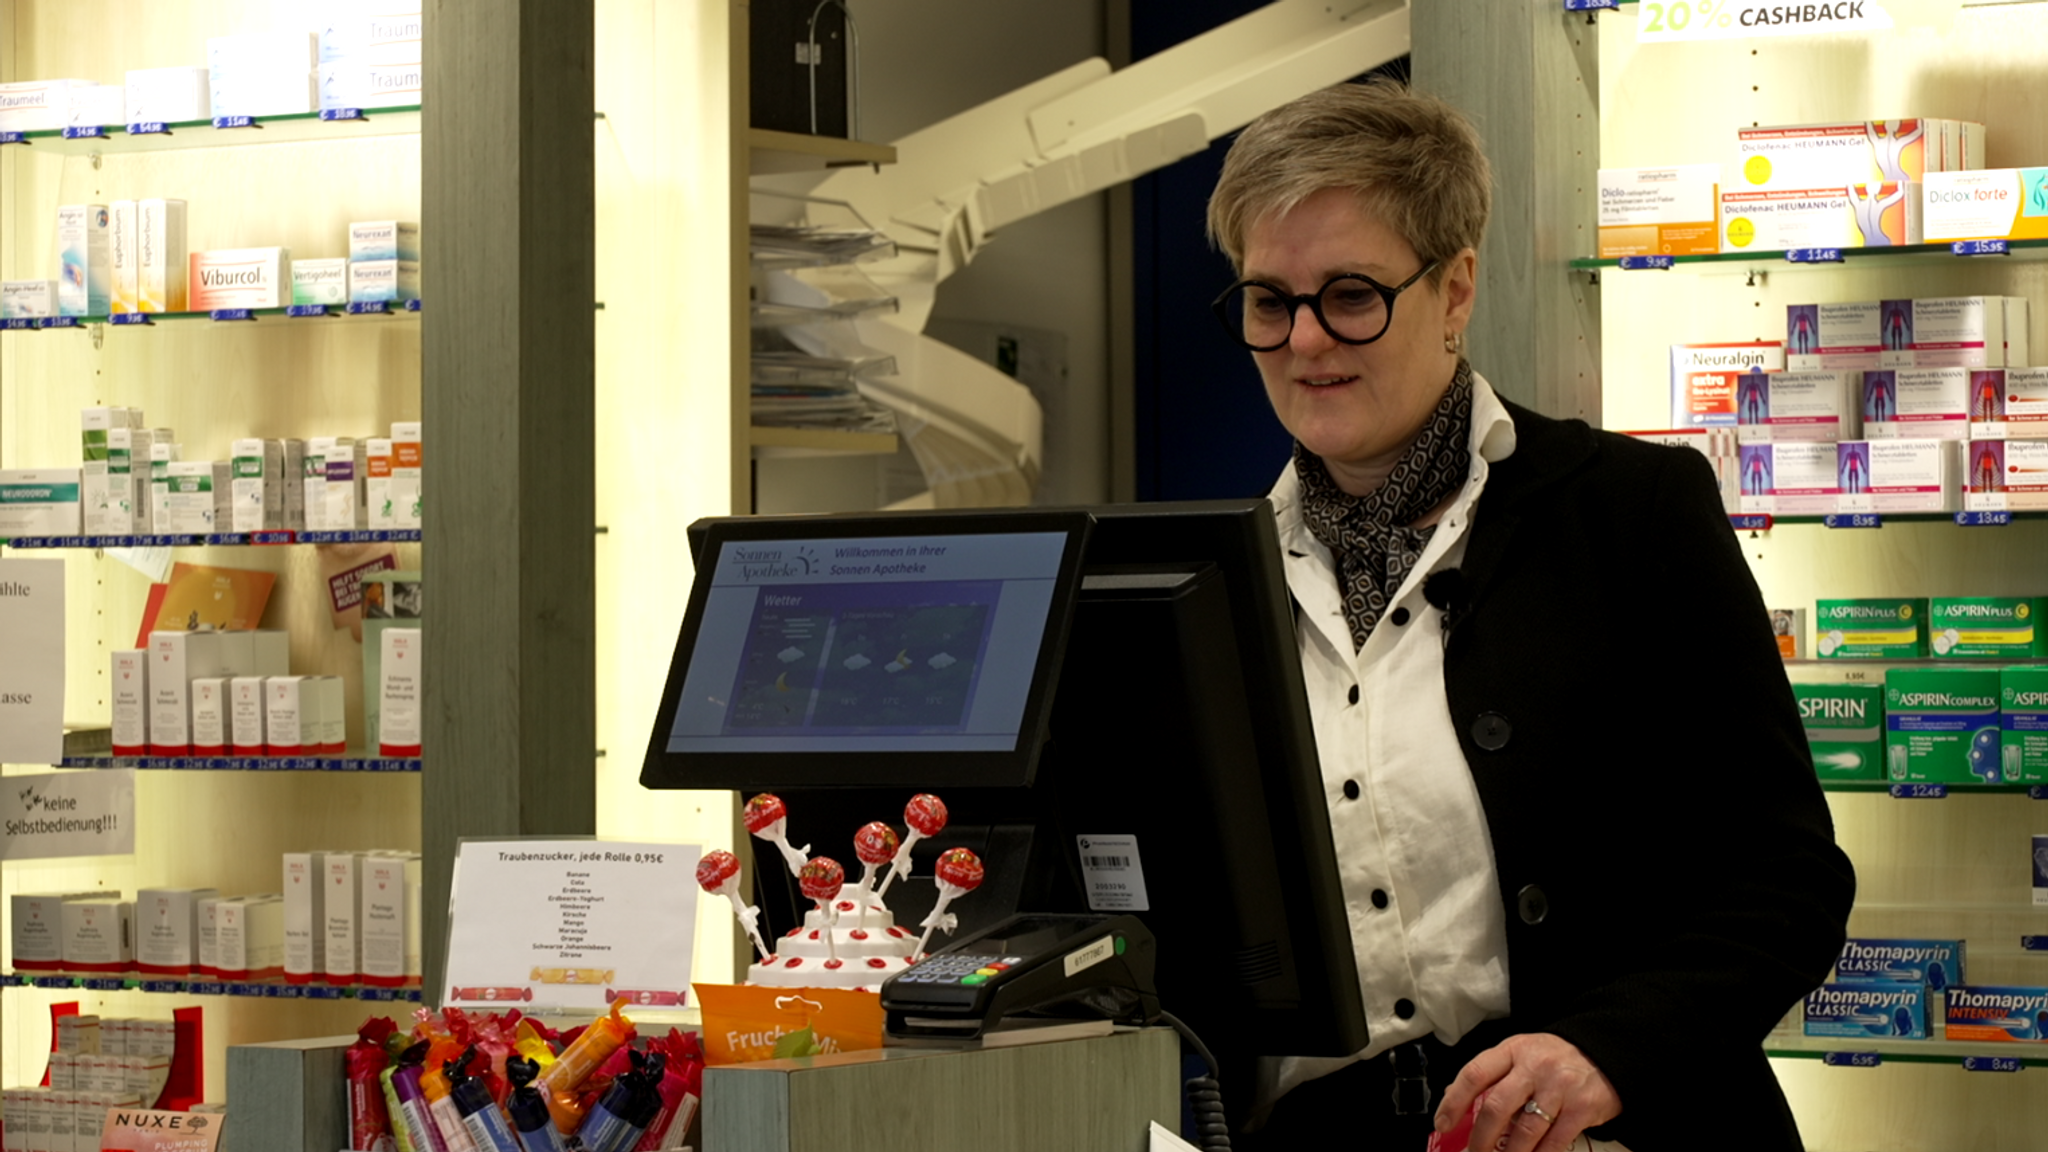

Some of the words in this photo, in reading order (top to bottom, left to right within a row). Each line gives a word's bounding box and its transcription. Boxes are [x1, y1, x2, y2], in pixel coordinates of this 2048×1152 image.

[1738, 2, 1864, 27] CASHBACK
[1741, 142, 1791, 152] Diclofenac
[1795, 139, 1846, 149] HEUMANN
[1848, 137, 1865, 146] Gel
[1930, 189, 1970, 203] Diclox
[1974, 188, 2008, 201] forte
[1724, 203, 1774, 214] Diclofenac
[1777, 201, 1828, 212] HEUMANN
[1830, 200, 1846, 209] Gel
[201, 266, 261, 286] Viburcol
[293, 268, 341, 282] Vertigoheel
[1850, 304, 1881, 312] HEUMAN
[1945, 299, 1981, 308] HEUMANN
[1692, 350, 1765, 368] Neuralgin
[1692, 373, 1726, 387] extra
[1800, 374, 1836, 382] HEUMANN
[1927, 371, 1963, 380] HEUMANN
[734, 546, 782, 561] Sonnen
[835, 547, 903, 560] Willkommen
[905, 546, 916, 557] in
[919, 545, 947, 557] Ihrer
[738, 563, 798, 582] Apotheke
[829, 564, 871, 576] Sonnen
[873, 563, 927, 577] Apotheke
[764, 593, 803, 607] Wetter
[1829, 606, 1874, 618] ASPIRIN
[1874, 609, 1896, 618] PLUS
[1944, 604, 1991, 617] ASPIRIN
[1990, 607, 2013, 617] PLUS
[1899, 692, 1950, 708] ASPIRIN
[1950, 696, 1996, 707] COMPLEX
[43, 795, 77, 812] keine
[5, 813, 118, 837] Selbstbedienung!!!
[498, 851, 577, 863] Traubenzucker,
[579, 851, 601, 864] jede
[604, 852, 632, 863] Rolle
[634, 852, 664, 864] 0,95€
[563, 919, 585, 927] Mango
[560, 935, 584, 943] Orange
[532, 943, 564, 951] Schwarze
[564, 943, 612, 952] Johannisbeere
[1841, 941, 1950, 963] Thomapyrin
[559, 951, 583, 959] Zitrone
[1838, 959, 1893, 972] CLASSIC
[1809, 986, 1917, 1009] Thomapyrin
[1807, 1004, 1860, 1016] CLASSIC
[1948, 1007, 2011, 1020] INTENSIV
[115, 1112, 184, 1130] NUXE
